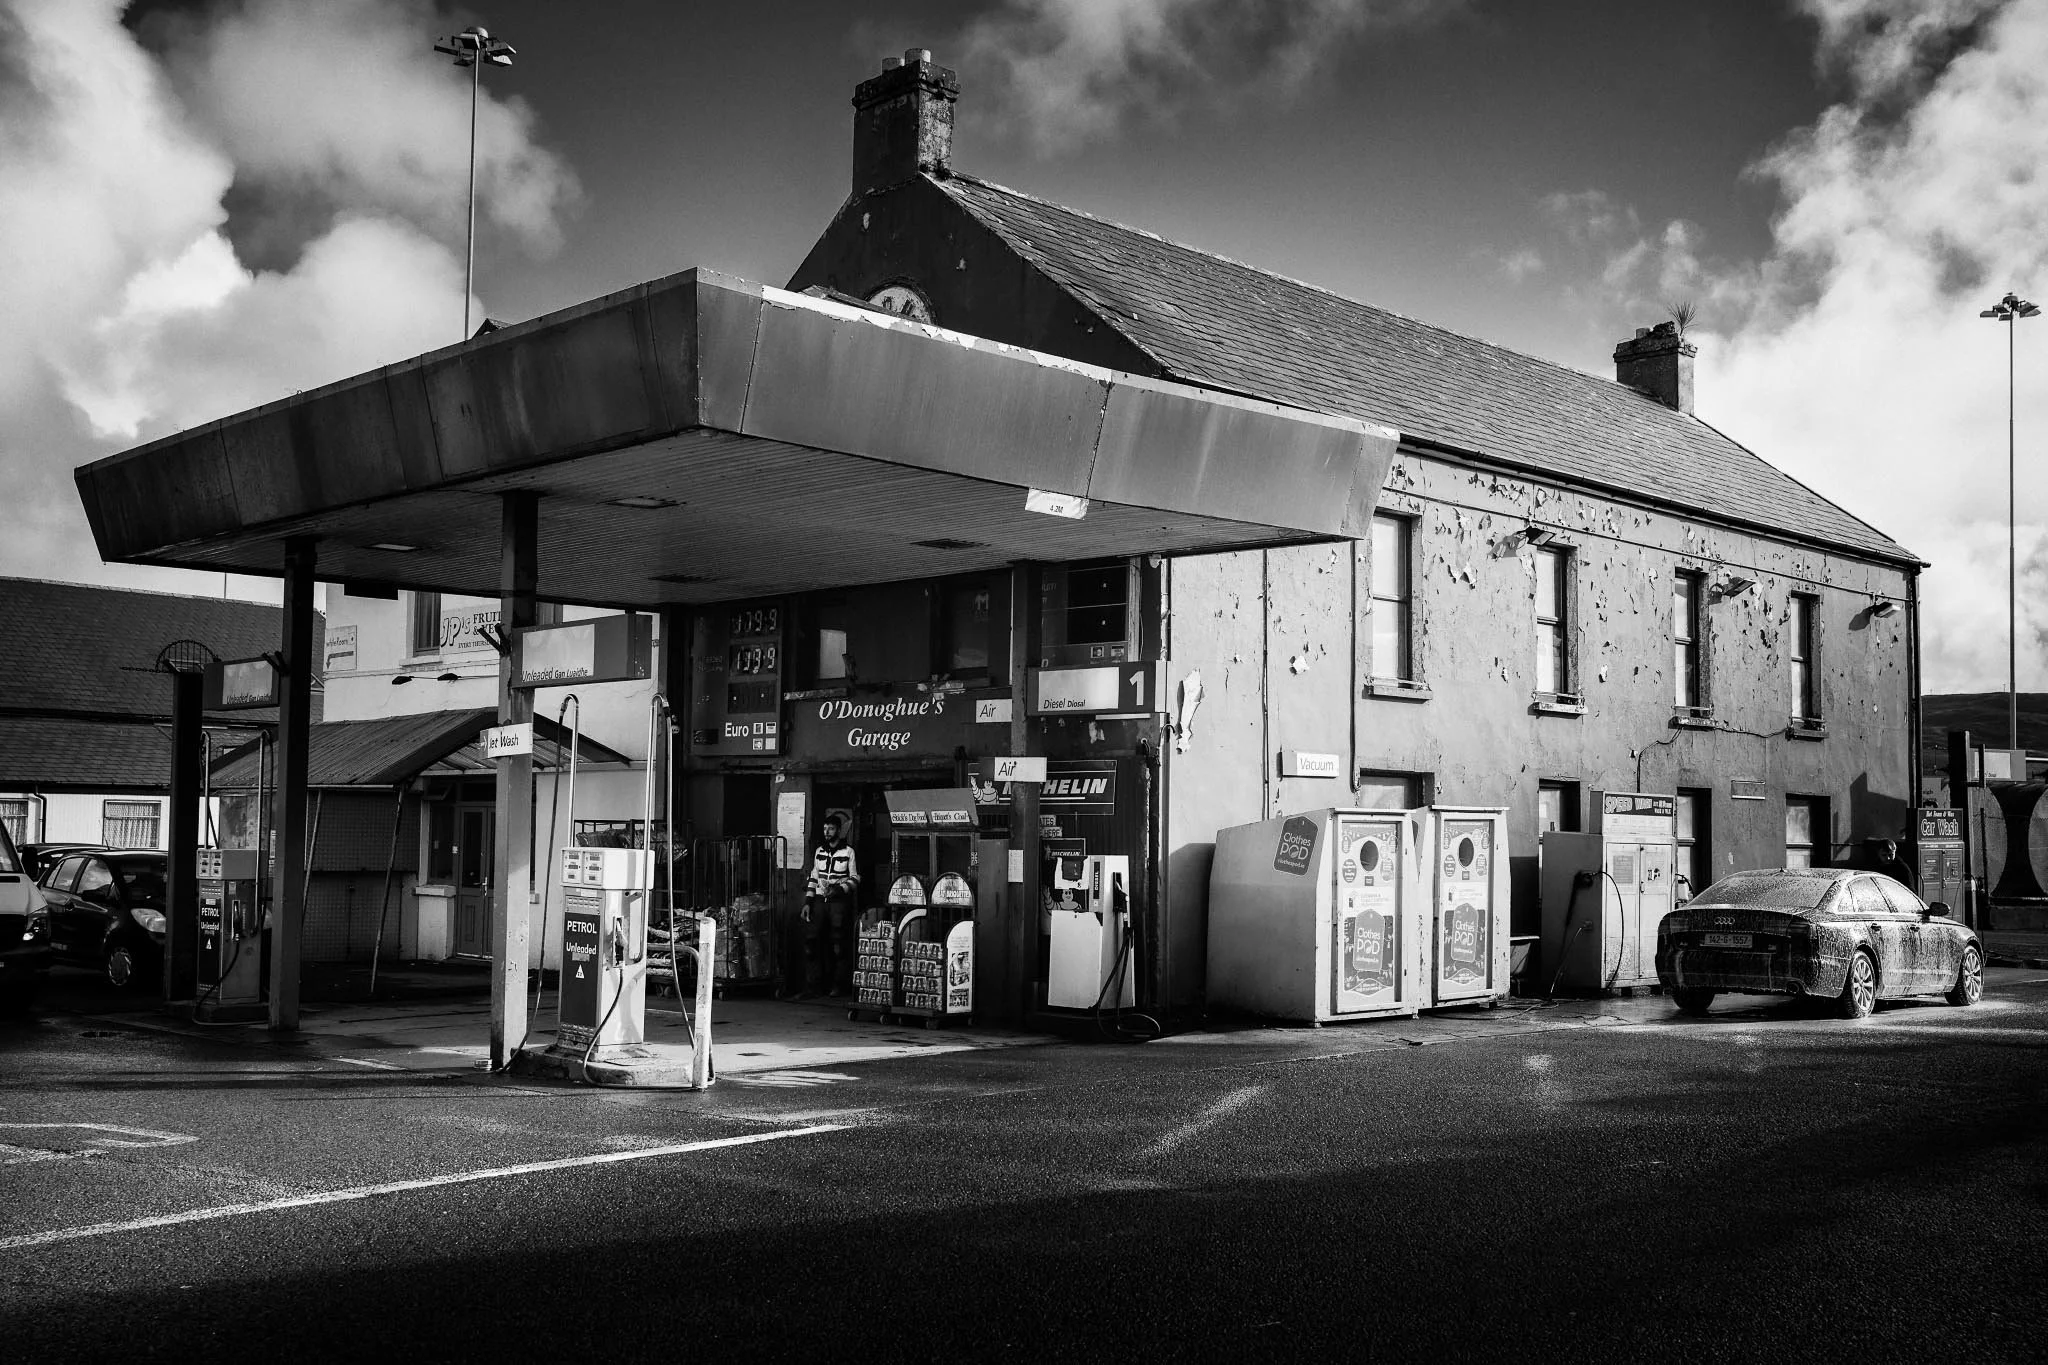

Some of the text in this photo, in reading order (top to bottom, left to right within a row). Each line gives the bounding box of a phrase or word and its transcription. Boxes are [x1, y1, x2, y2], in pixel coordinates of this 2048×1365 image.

[440, 616, 470, 648] JP's
[522, 666, 554, 682] Unleaded
[554, 670, 566, 678] Gan
[1129, 670, 1144, 706] 1
[819, 698, 944, 722] O'Donoghue's
[1044, 698, 1066, 708] Diesel
[980, 704, 996, 718] Air
[725, 722, 750, 737] Euro
[500, 731, 518, 748] Wash
[848, 728, 910, 750] Garage
[998, 762, 1016, 776] Air
[1300, 758, 1334, 770] Vacuum
[1002, 779, 1108, 794] HELIN
[1604, 796, 1632, 814] SPEED
[1920, 818, 1958, 836] Car Wash
[1284, 832, 1310, 846] Clothes
[1280, 842, 1308, 860] POD
[200, 907, 220, 917] PETROL
[200, 920, 220, 930] Unleaded
[566, 920, 598, 934] PETROL
[1357, 927, 1380, 940] Clothes
[566, 942, 597, 955] Unleaded
